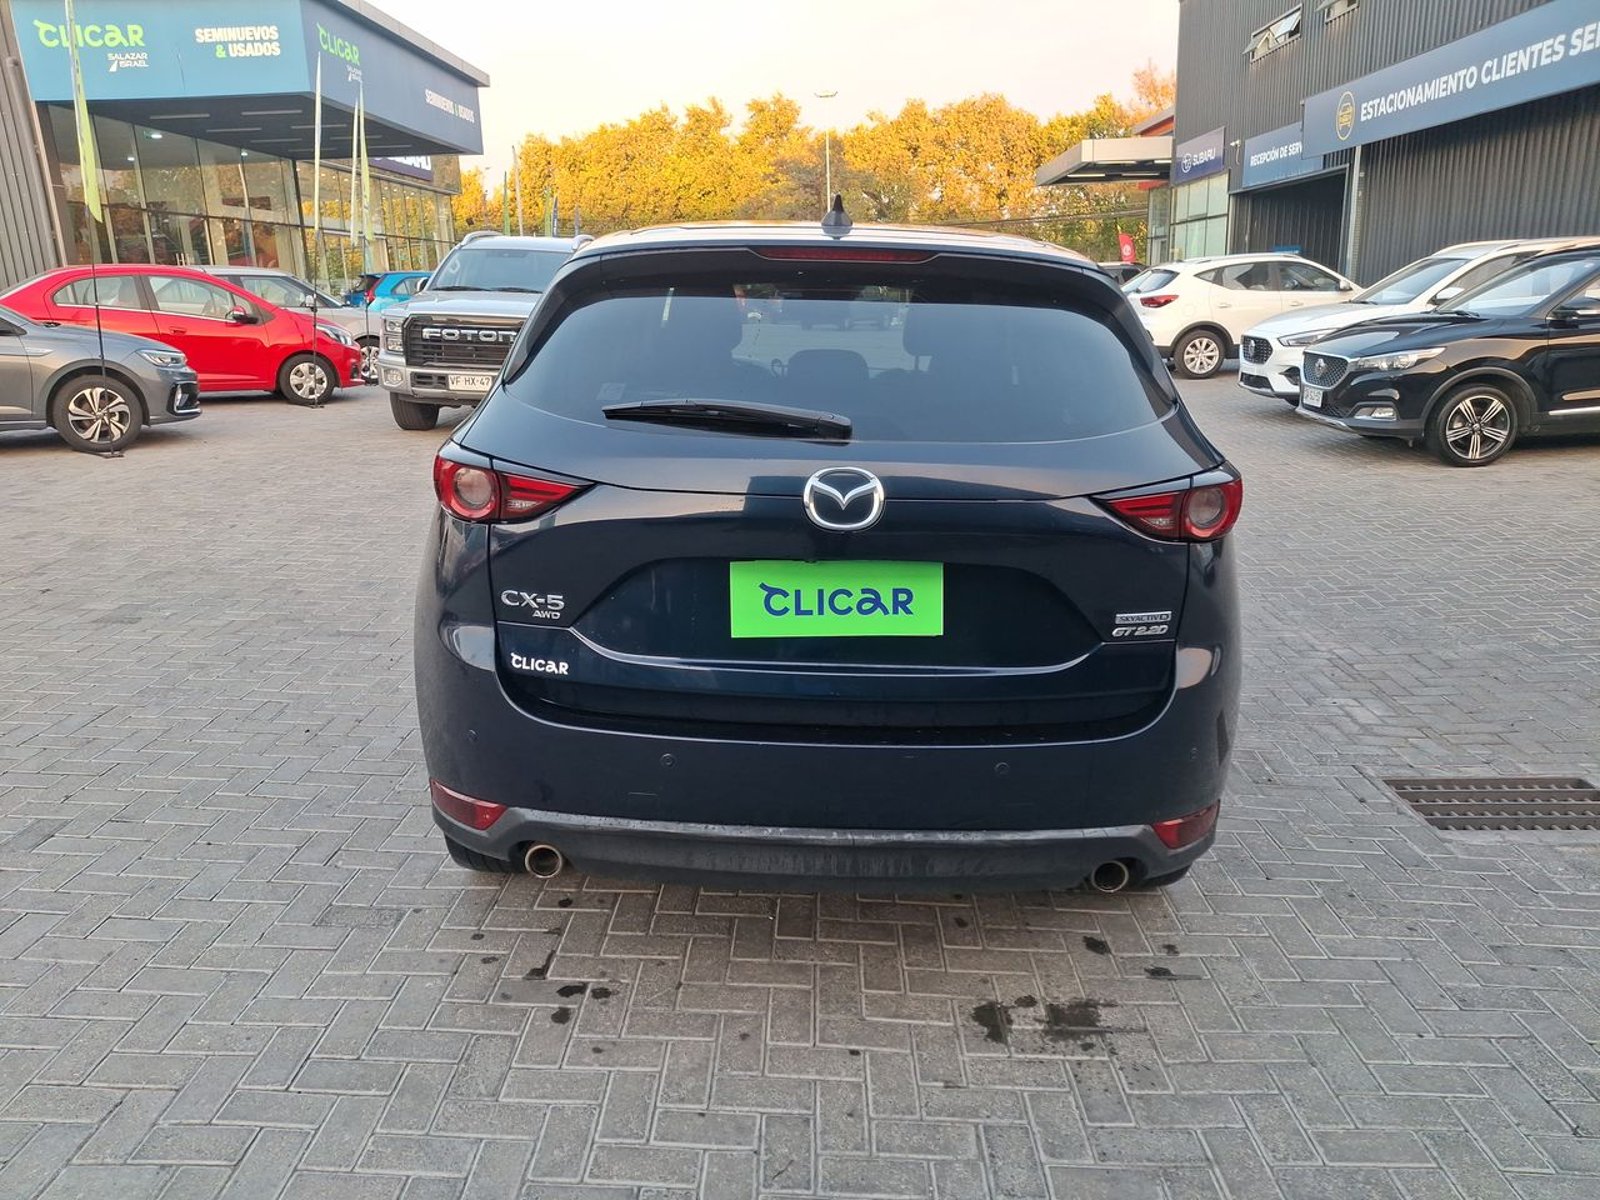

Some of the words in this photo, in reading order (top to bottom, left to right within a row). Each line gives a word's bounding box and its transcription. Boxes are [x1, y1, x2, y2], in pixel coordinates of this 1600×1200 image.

[194, 25, 279, 43] SEMINUEVOS
[107, 52, 149, 61] SALAZAR
[215, 43, 227, 58] &
[228, 41, 281, 57] USADOS
[1360, 65, 1478, 122] ESTACIONAMIENTO
[1480, 34, 1567, 85] CLIENTES
[1249, 148, 1280, 167] RECEPCIÓN
[1279, 145, 1289, 159] DE
[422, 327, 518, 342] FOTON
[500, 589, 566, 611] CX-5
[757, 581, 915, 617] CLICAR
[532, 610, 560, 619] AWD
[511, 652, 569, 675] CLICAR
